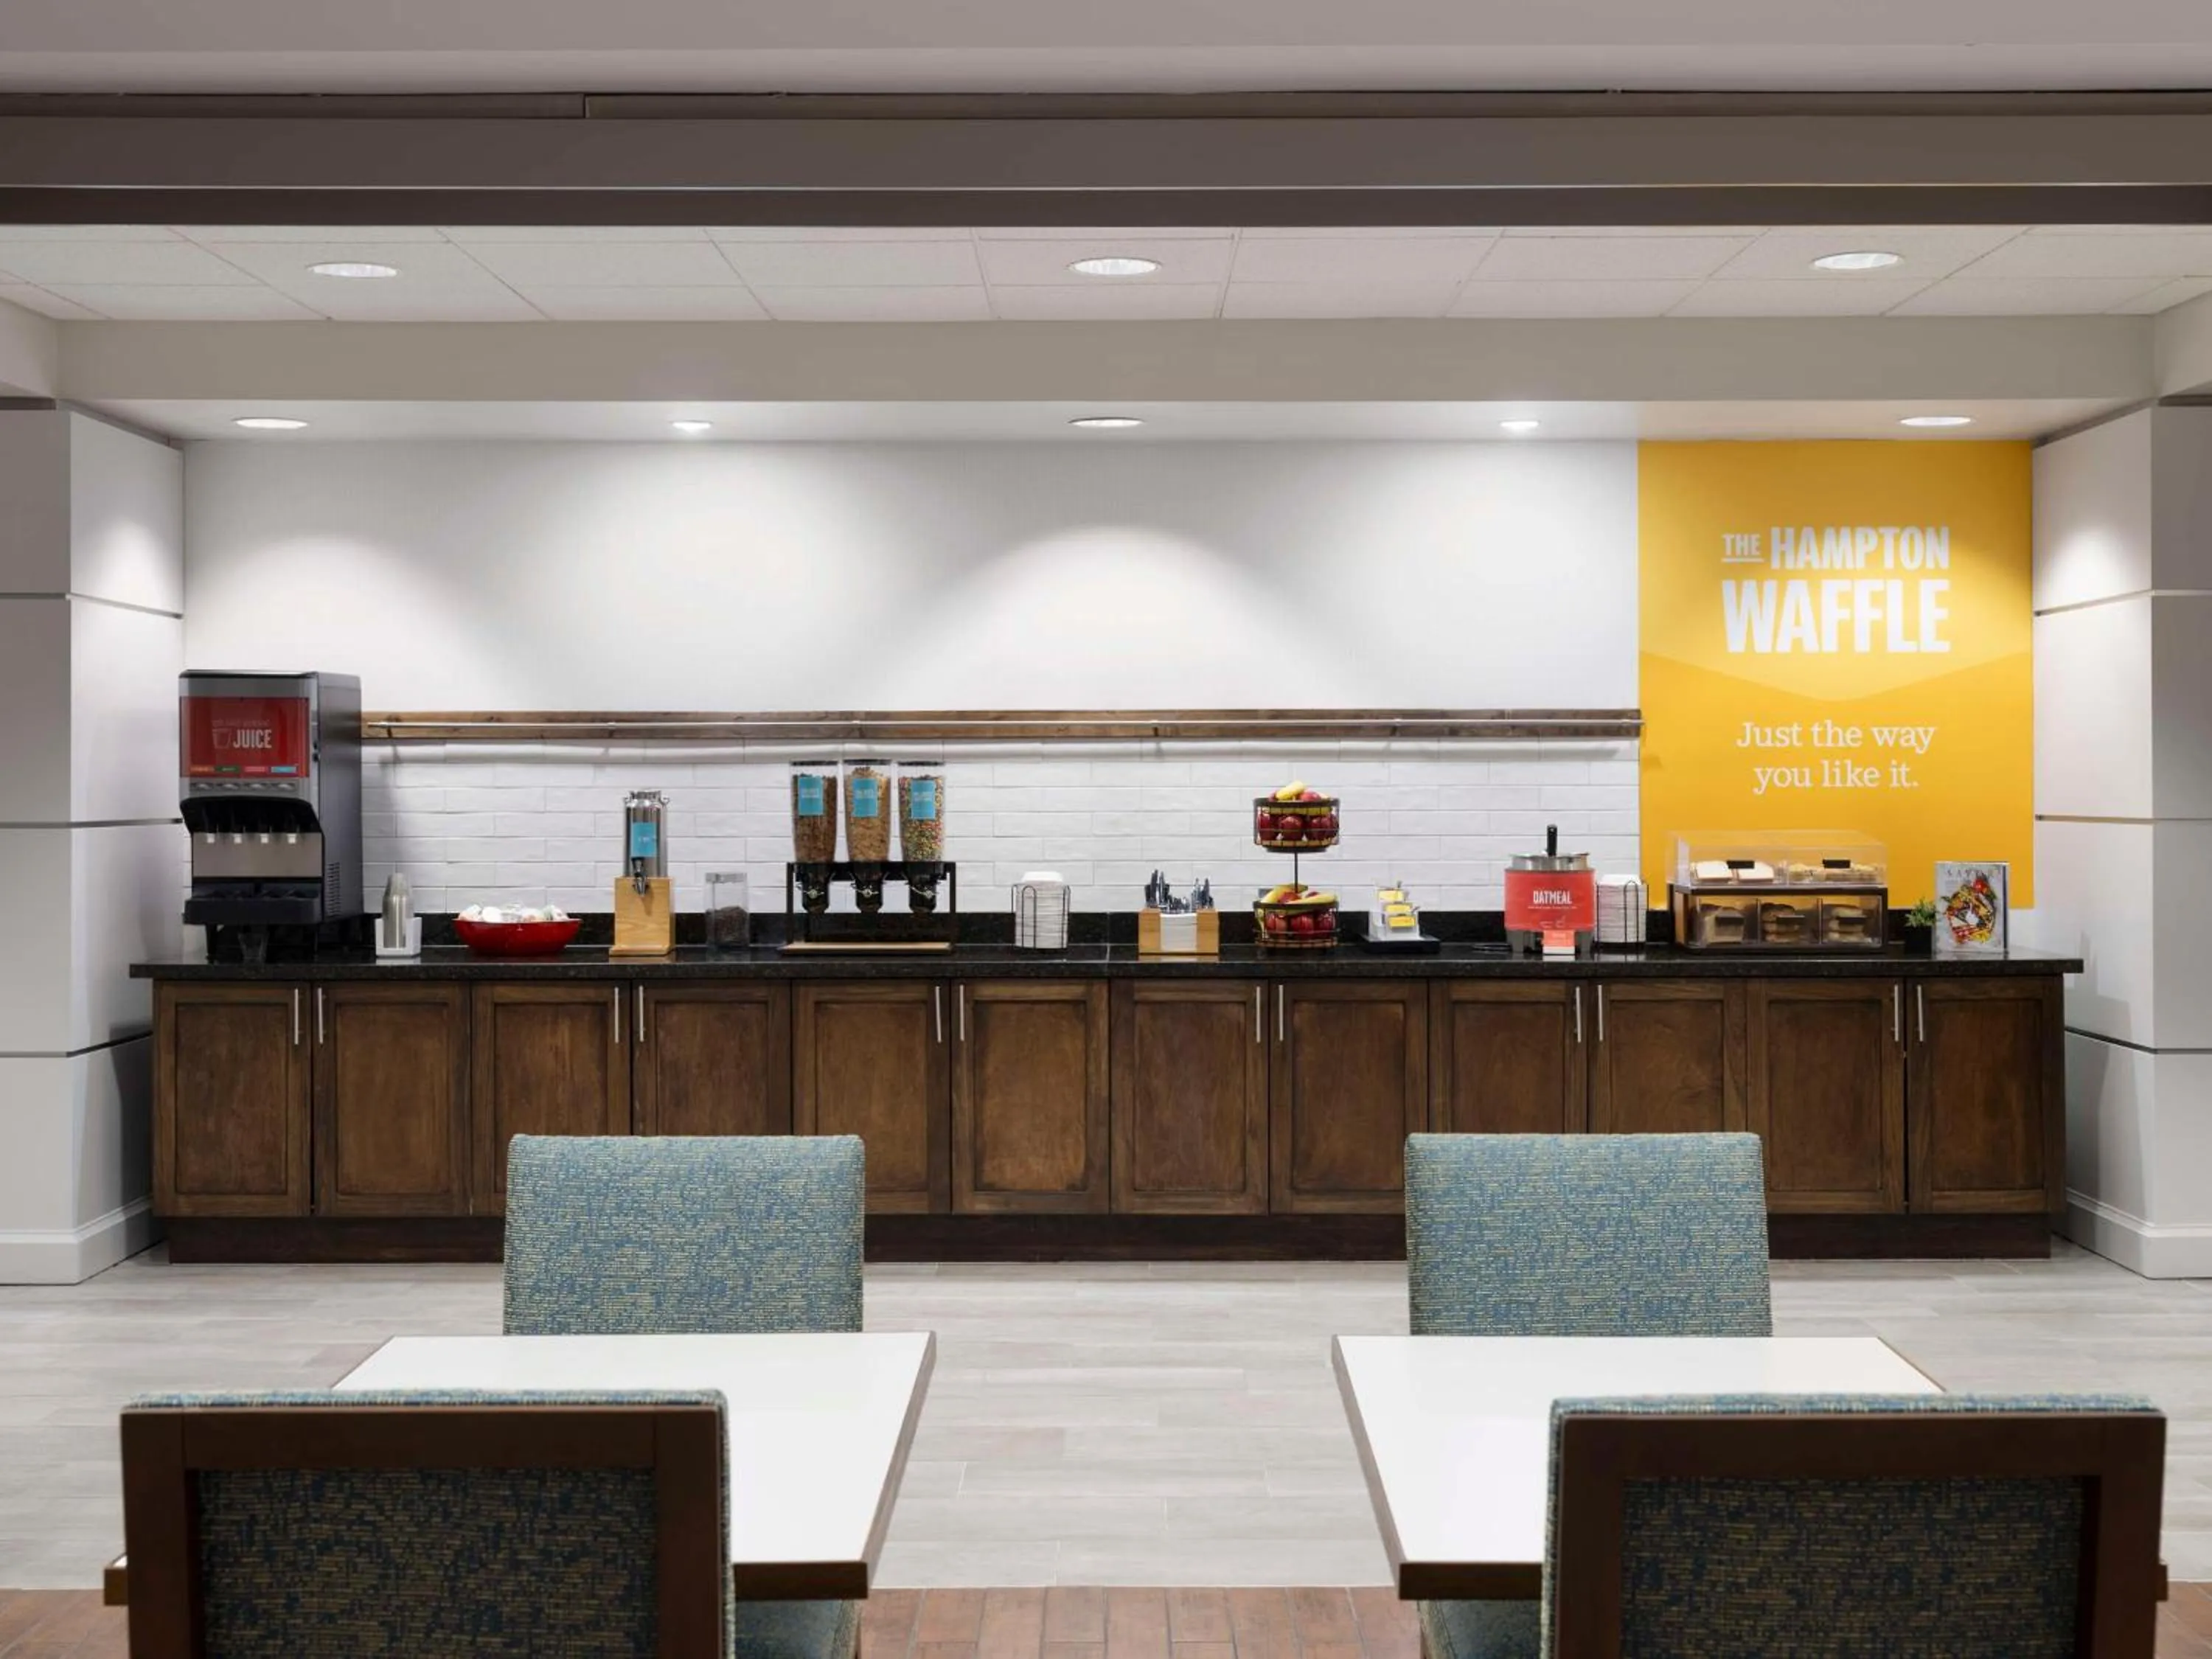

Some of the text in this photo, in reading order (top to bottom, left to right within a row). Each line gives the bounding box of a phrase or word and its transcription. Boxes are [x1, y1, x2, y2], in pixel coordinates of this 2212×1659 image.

[1722, 526, 1950, 570] THE HAMPTON
[1722, 579, 1951, 653] WAFFLE
[233, 728, 273, 748] JUICE
[1736, 720, 1936, 754] Just the way
[1753, 759, 1919, 795] you like it.
[1533, 890, 1573, 905] OATMEAL
